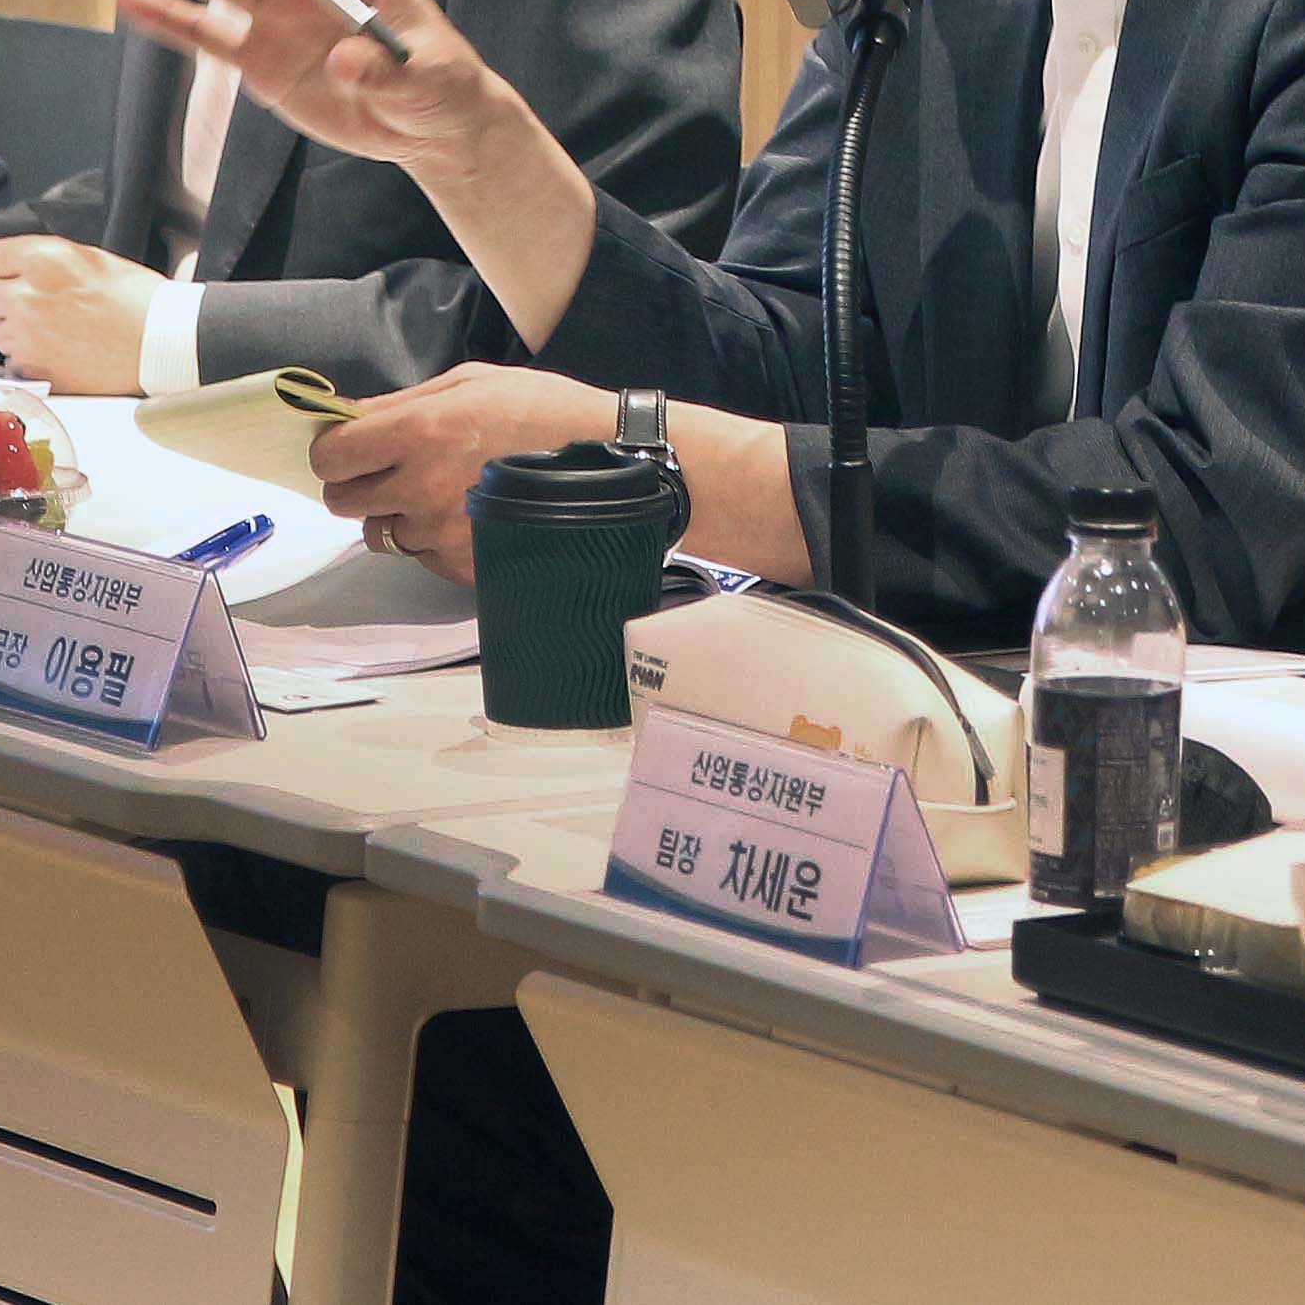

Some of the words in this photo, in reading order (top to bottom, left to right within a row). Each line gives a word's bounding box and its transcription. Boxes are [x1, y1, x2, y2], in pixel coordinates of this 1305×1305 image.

[23, 557, 143, 615] 산업통상자원부
[44, 635, 135, 708] 이용필
[691, 749, 827, 817] 산업통상자원부
[655, 828, 701, 875] 팀장
[719, 839, 823, 922] 차세운
